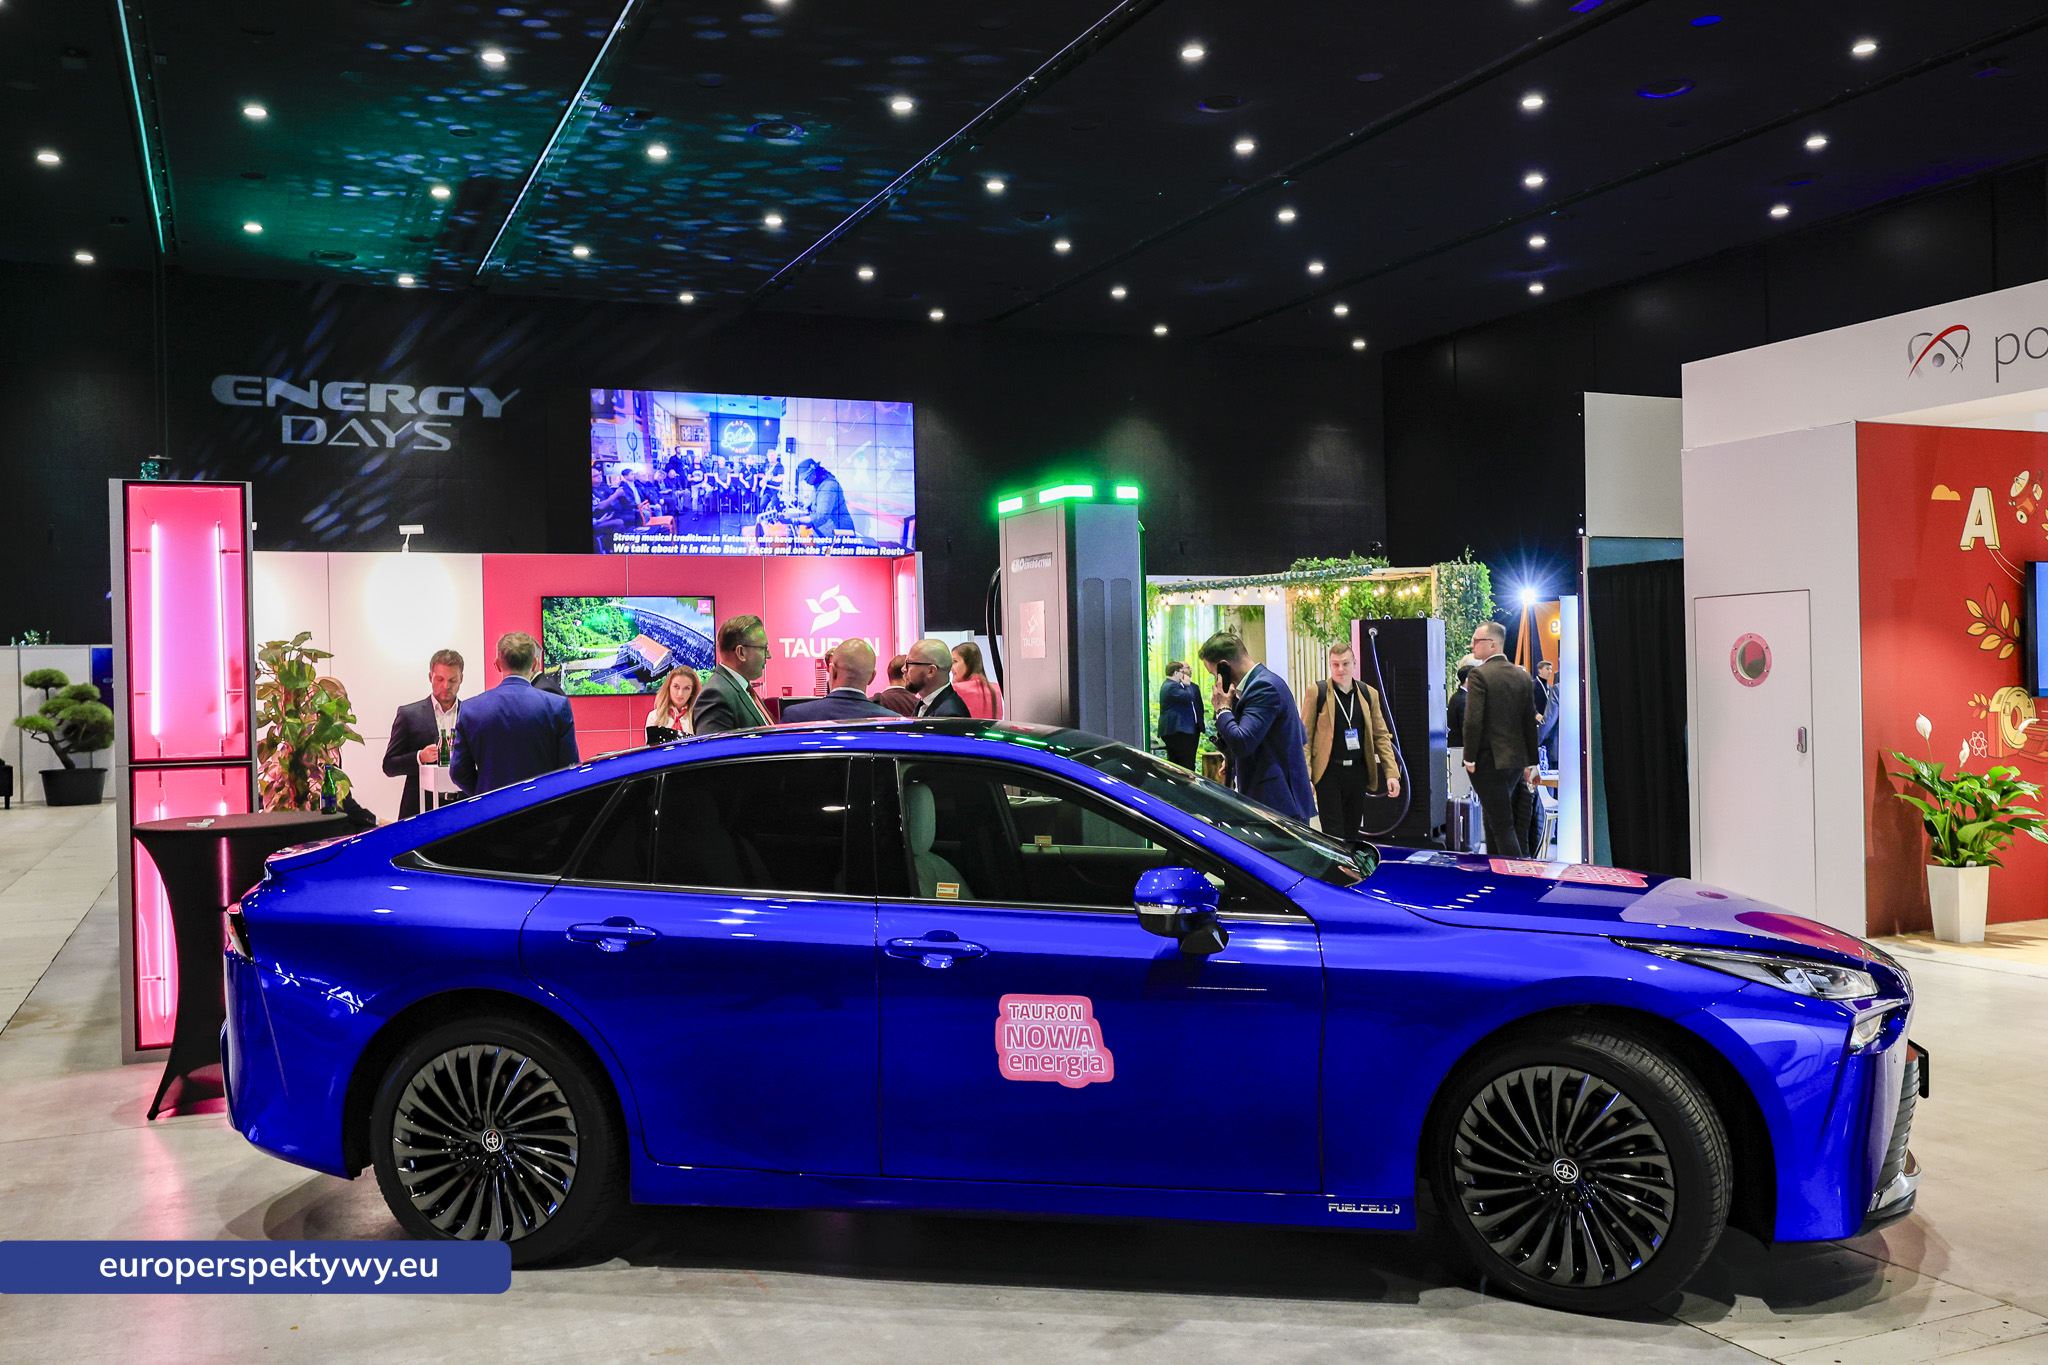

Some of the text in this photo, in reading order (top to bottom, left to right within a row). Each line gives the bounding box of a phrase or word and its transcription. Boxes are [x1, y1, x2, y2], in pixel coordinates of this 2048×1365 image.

[211, 375, 521, 418] ENERGY
[281, 415, 452, 451] DAYS
[1960, 486, 2001, 551] A
[613, 533, 863, 544] Strong musical traditions in Katowice also have their roots in blues.
[613, 543, 905, 556] We talk about it in Kato Blues Faces and on the Slesian Blues Route
[1008, 1003, 1084, 1022] TAURON
[1005, 1024, 1096, 1051] NOWA
[1008, 1049, 1105, 1079] energia
